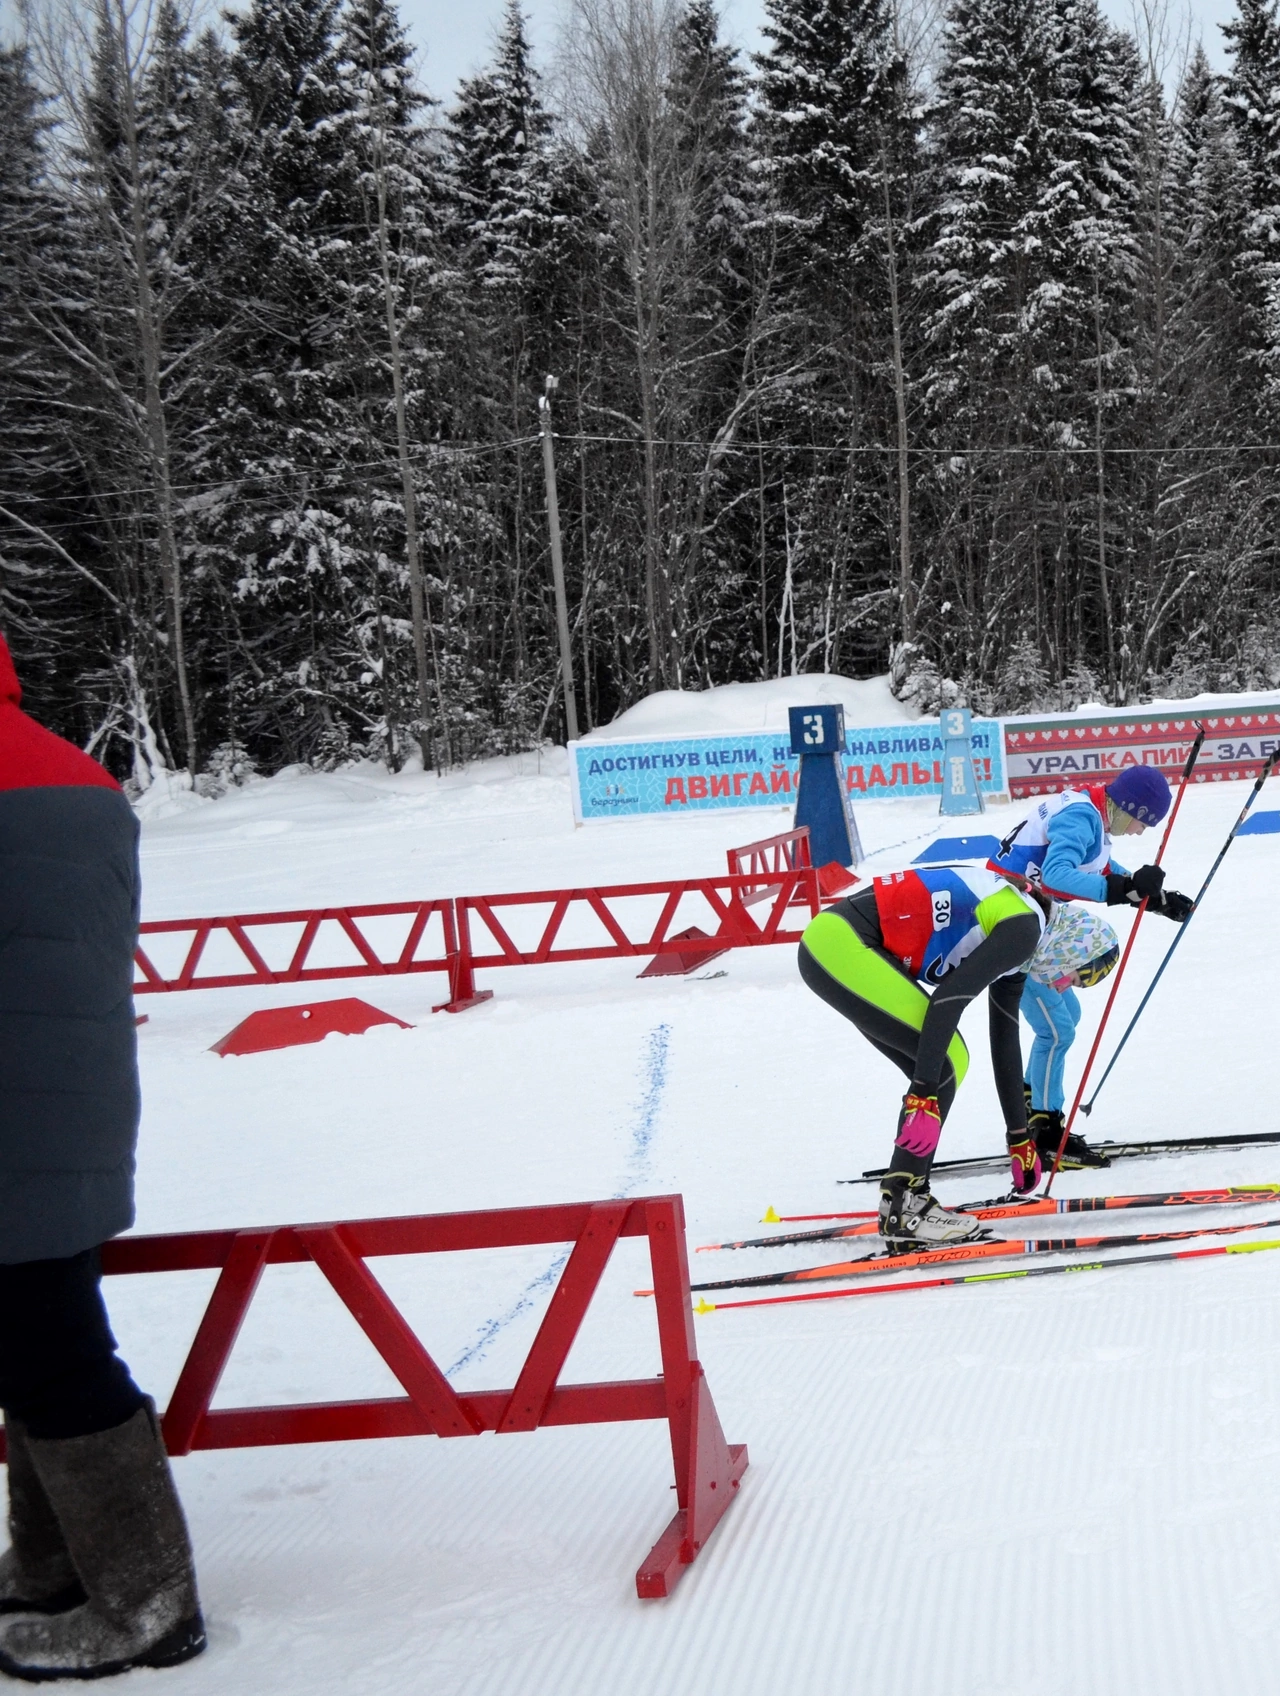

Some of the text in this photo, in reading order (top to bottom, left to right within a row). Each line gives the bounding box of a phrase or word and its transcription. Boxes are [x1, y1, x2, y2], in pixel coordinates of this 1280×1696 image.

[803, 714, 825, 745] 3
[947, 712, 965, 735] 3
[588, 751, 700, 776] ДОСТИГНУВ
[705, 748, 763, 768] ЦЕЛИ,
[1217, 742, 1255, 760] ЗА
[664, 764, 801, 806] ДВИГАЙ
[935, 899, 950, 924] 30
